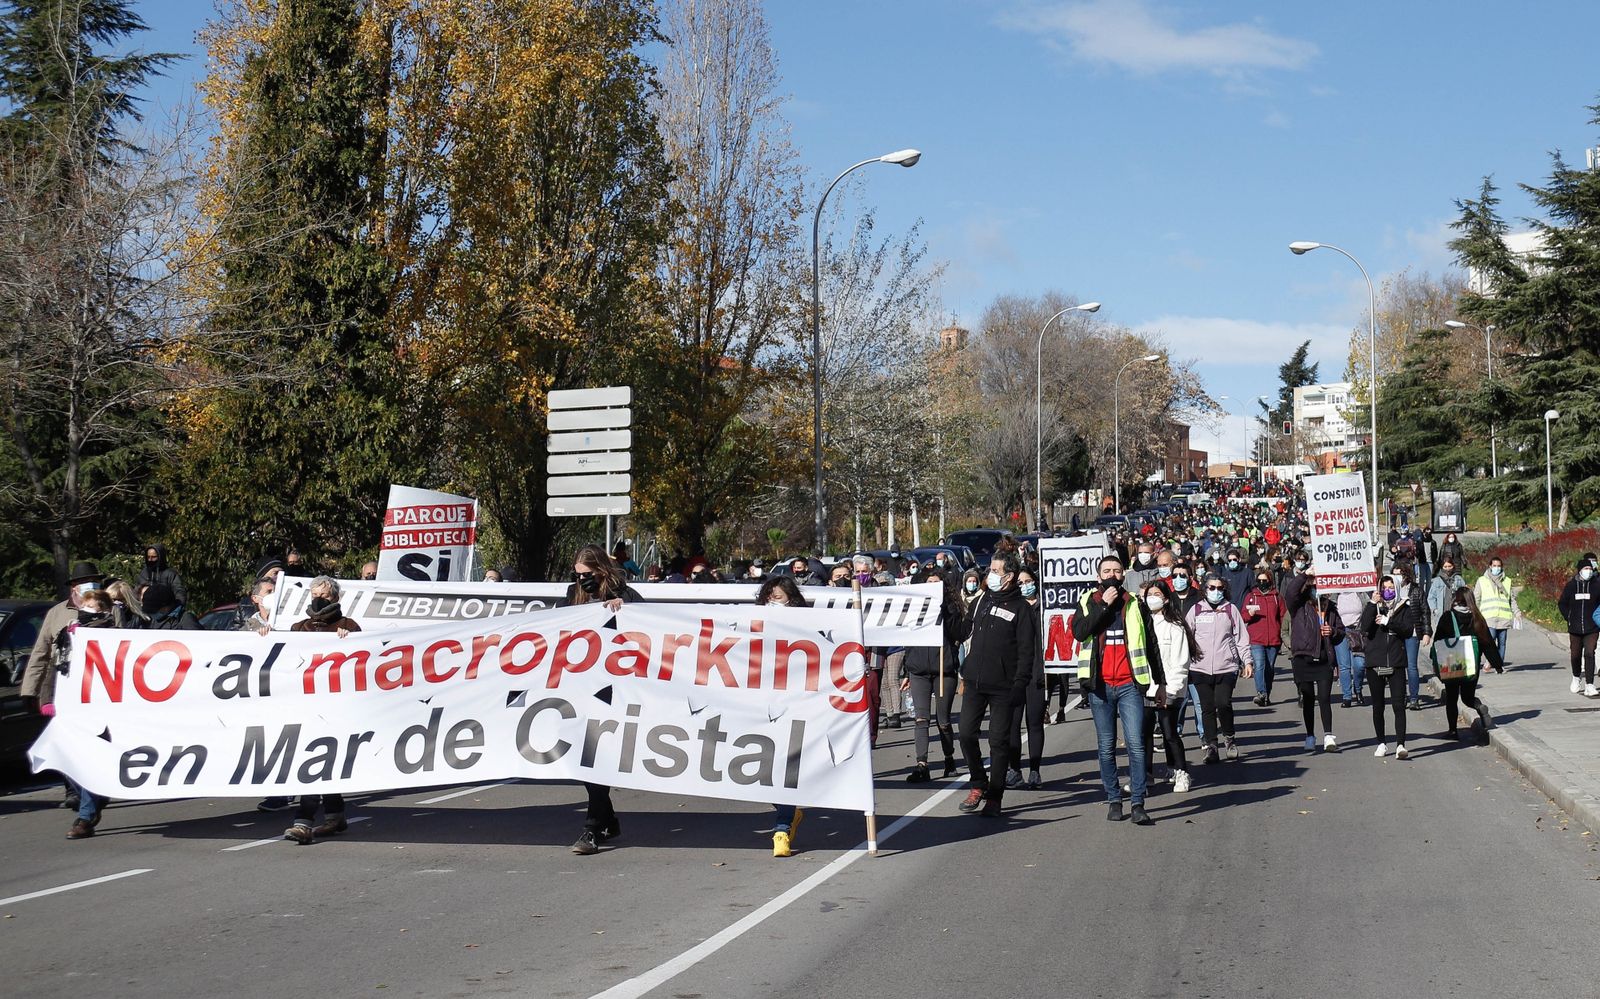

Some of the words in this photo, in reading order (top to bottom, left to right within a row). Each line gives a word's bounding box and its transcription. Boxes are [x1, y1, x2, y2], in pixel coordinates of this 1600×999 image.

[1314, 487, 1360, 501] CONSTRUIR
[393, 507, 466, 525] PARQUE
[1314, 507, 1364, 522] PARKINGS
[1315, 523, 1334, 536] DE
[1338, 519, 1365, 534] PAGO
[384, 531, 467, 547] BIBLIOTECA
[1317, 543, 1336, 553] CON
[1339, 540, 1367, 551] DINERO
[1317, 574, 1373, 586] ESPECULACIÓN
[379, 597, 556, 618] BIBLIOTEC
[1045, 614, 1081, 661] N
[81, 640, 193, 704] NO
[211, 642, 286, 700] al
[303, 619, 868, 713] macroparking
[119, 744, 208, 788] en
[229, 723, 375, 785] Mar
[394, 707, 485, 774] de
[515, 697, 806, 789] Cristal
